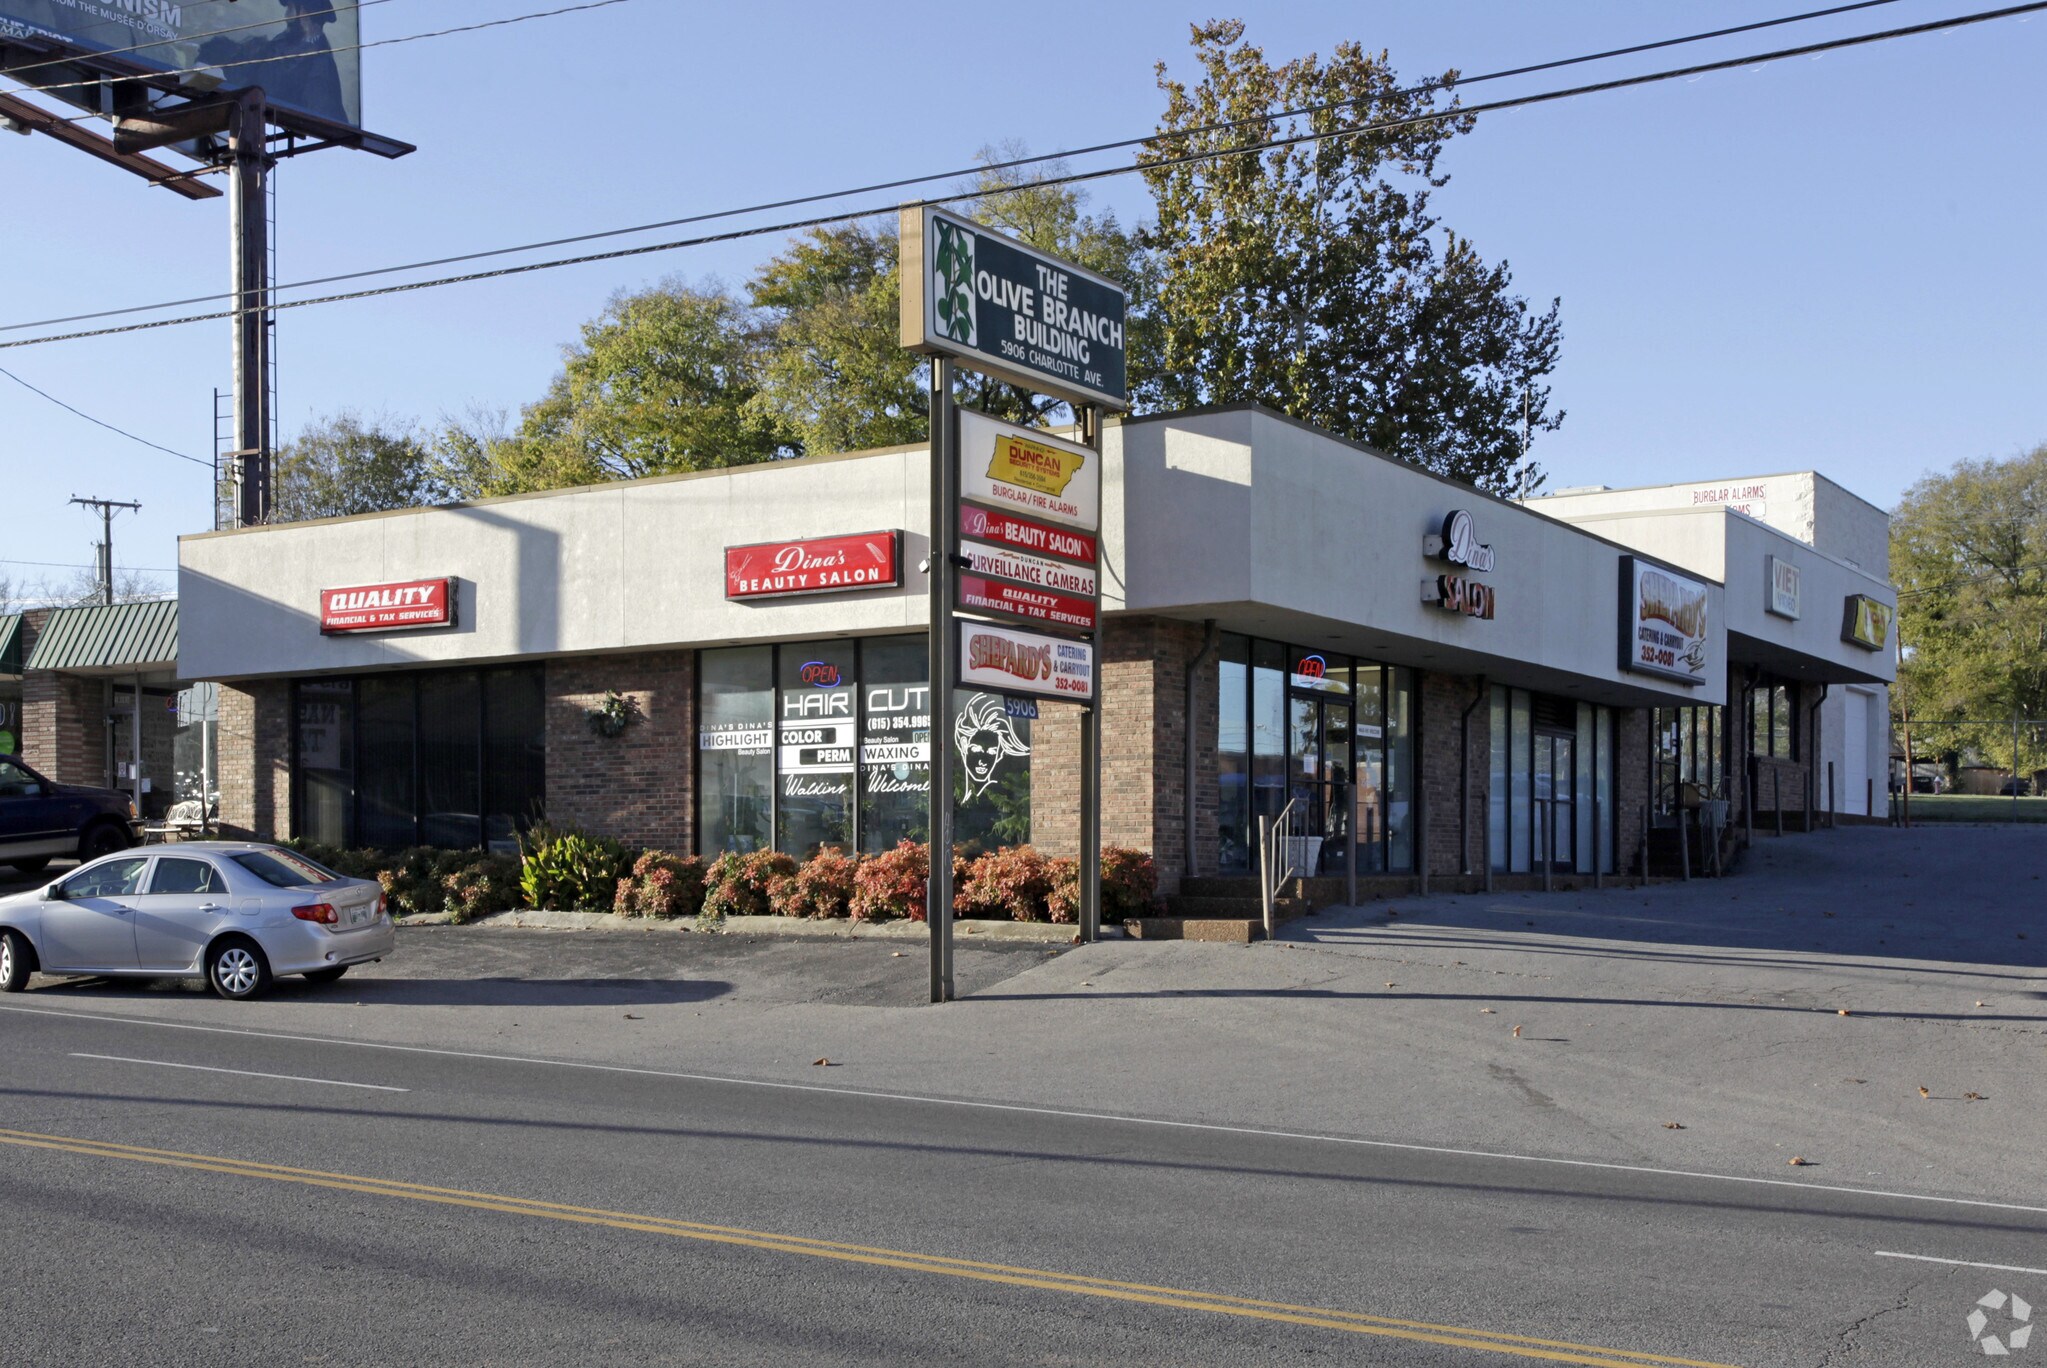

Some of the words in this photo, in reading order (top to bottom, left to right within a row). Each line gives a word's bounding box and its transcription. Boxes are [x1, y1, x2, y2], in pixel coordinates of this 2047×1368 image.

[79, 2, 98, 15] THE
[101, 8, 134, 27] MUSÉE
[1036, 264, 1068, 300] THE
[977, 270, 1034, 316] OLIVE
[1043, 298, 1123, 350] BRANCH
[1014, 315, 1090, 365] BUILDING
[1001, 340, 1025, 360] 5906
[1029, 350, 1079, 379] CHARLOTTE
[1084, 370, 1104, 388] AVE.
[1009, 445, 1060, 471] DUNCAN
[1694, 489, 1729, 504] BURGLAR
[1732, 485, 1764, 499] ALARMS
[1049, 502, 1078, 517] ALARMS
[973, 513, 1004, 534] Dina's
[1005, 522, 1046, 548] BEAUTY
[1050, 534, 1082, 557] SALON
[771, 546, 846, 573] Dina's
[1020, 555, 1044, 567] DUNCAN
[740, 574, 808, 592] BEAUTY
[819, 567, 879, 585] SALON
[1046, 570, 1094, 595] CAMERAS
[1774, 563, 1799, 596] VIET
[330, 585, 436, 611] QUALITY
[1003, 588, 1058, 606] QUALITY
[1443, 575, 1495, 620] SALON
[326, 615, 366, 625] FINANCIAL
[370, 614, 376, 622] &
[379, 613, 395, 621] TAX
[399, 609, 440, 620] SERVICES
[966, 594, 1013, 612] FINANCIAL
[1018, 604, 1024, 613] &
[1029, 606, 1046, 618] TAX
[1050, 611, 1091, 626] SERVICES
[969, 634, 1052, 681] SHEPARD'S
[1057, 644, 1086, 661] CATERING
[1641, 645, 1674, 667] 352-0081
[802, 665, 838, 683] OPEN
[1053, 661, 1059, 672] &
[1060, 660, 1090, 677] CARRYOUT
[1298, 658, 1322, 679] OPEN
[1056, 677, 1088, 693] 352-0081
[784, 692, 849, 717] HAIR
[868, 687, 929, 712] CUT
[1007, 697, 1036, 717] 5906
[700, 723, 734, 731] DINA'S
[738, 721, 772, 730] DINA'S
[868, 717, 890, 731] (615)
[703, 733, 768, 747] HIGHLIGHT
[782, 730, 822, 744] COLOR
[864, 737, 882, 745] Beauty
[738, 748, 755, 757] Beauty
[817, 749, 850, 763] PERM
[865, 746, 920, 759] WAXING
[861, 764, 896, 772] DINA'S
[868, 771, 930, 793] Welcome
